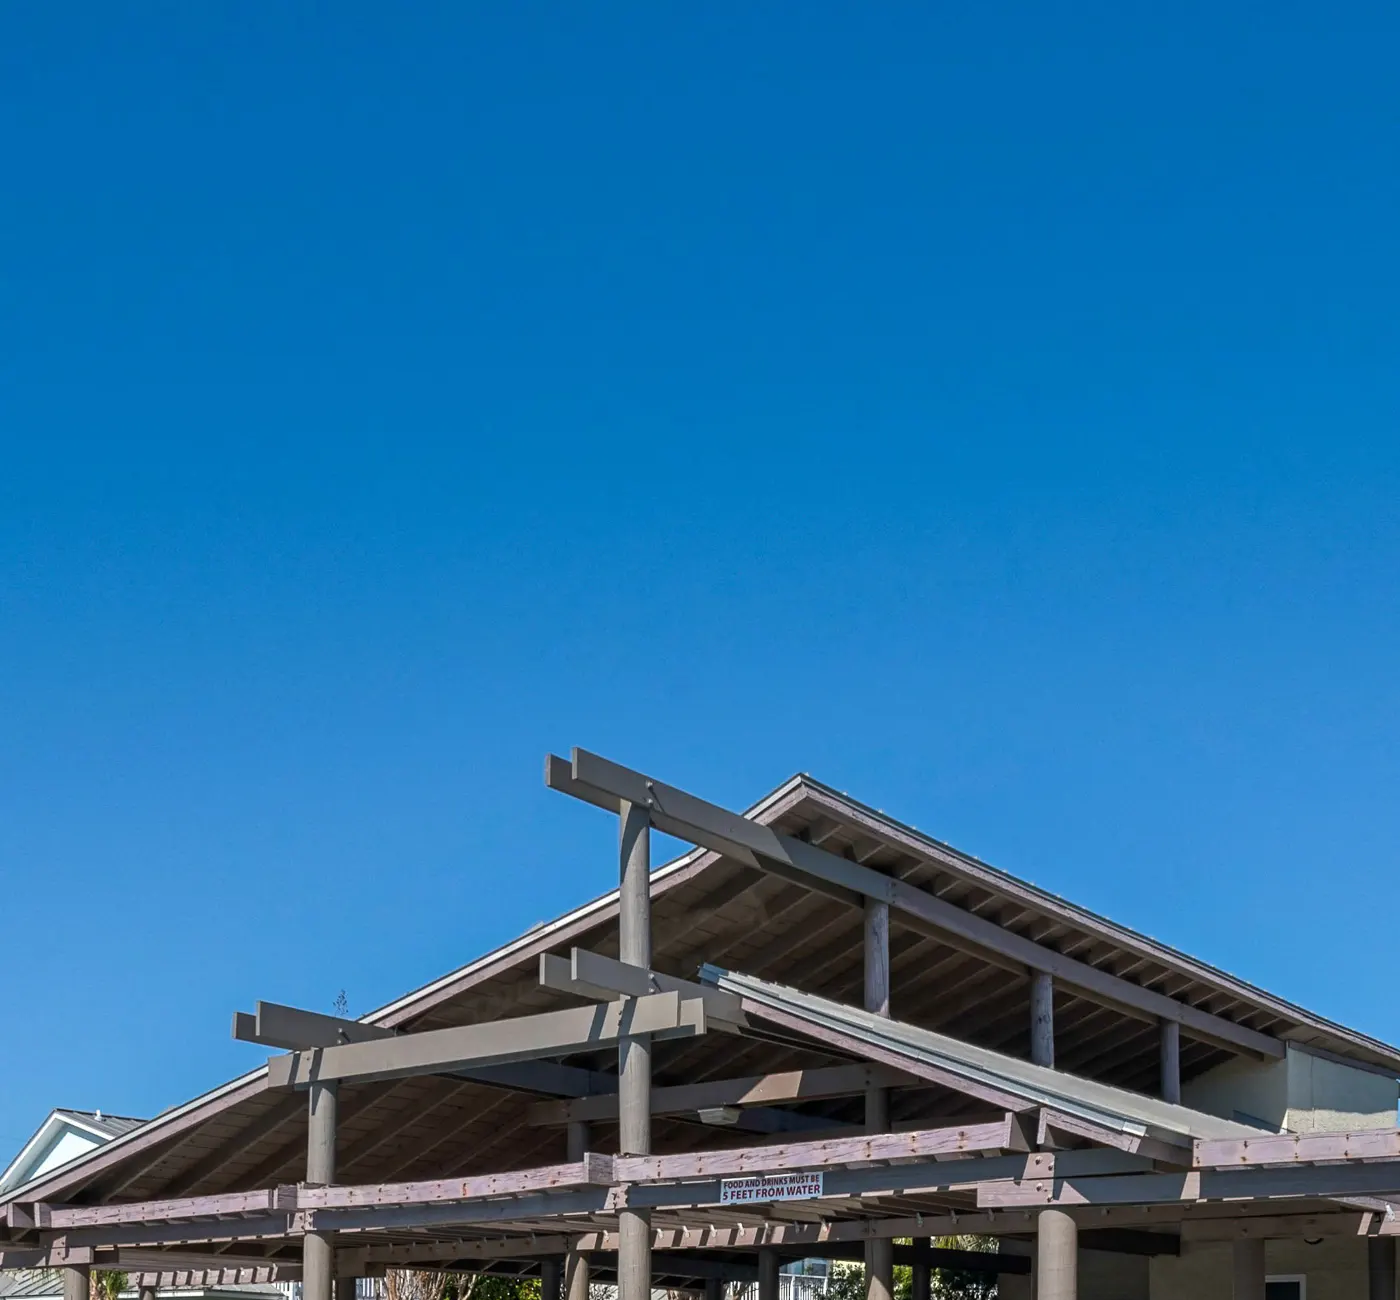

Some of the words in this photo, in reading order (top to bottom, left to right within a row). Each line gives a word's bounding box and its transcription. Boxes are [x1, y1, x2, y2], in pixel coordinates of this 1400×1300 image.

[723, 1180, 744, 1189] FOOD
[745, 1179, 759, 1188] AND
[761, 1177, 788, 1187] DRINKS
[788, 1175, 810, 1184] MUST
[811, 1174, 820, 1183] BE
[723, 1191, 728, 1200] 5
[730, 1189, 754, 1200] FEET
[756, 1187, 784, 1198] FROM
[786, 1184, 820, 1196] WATER
